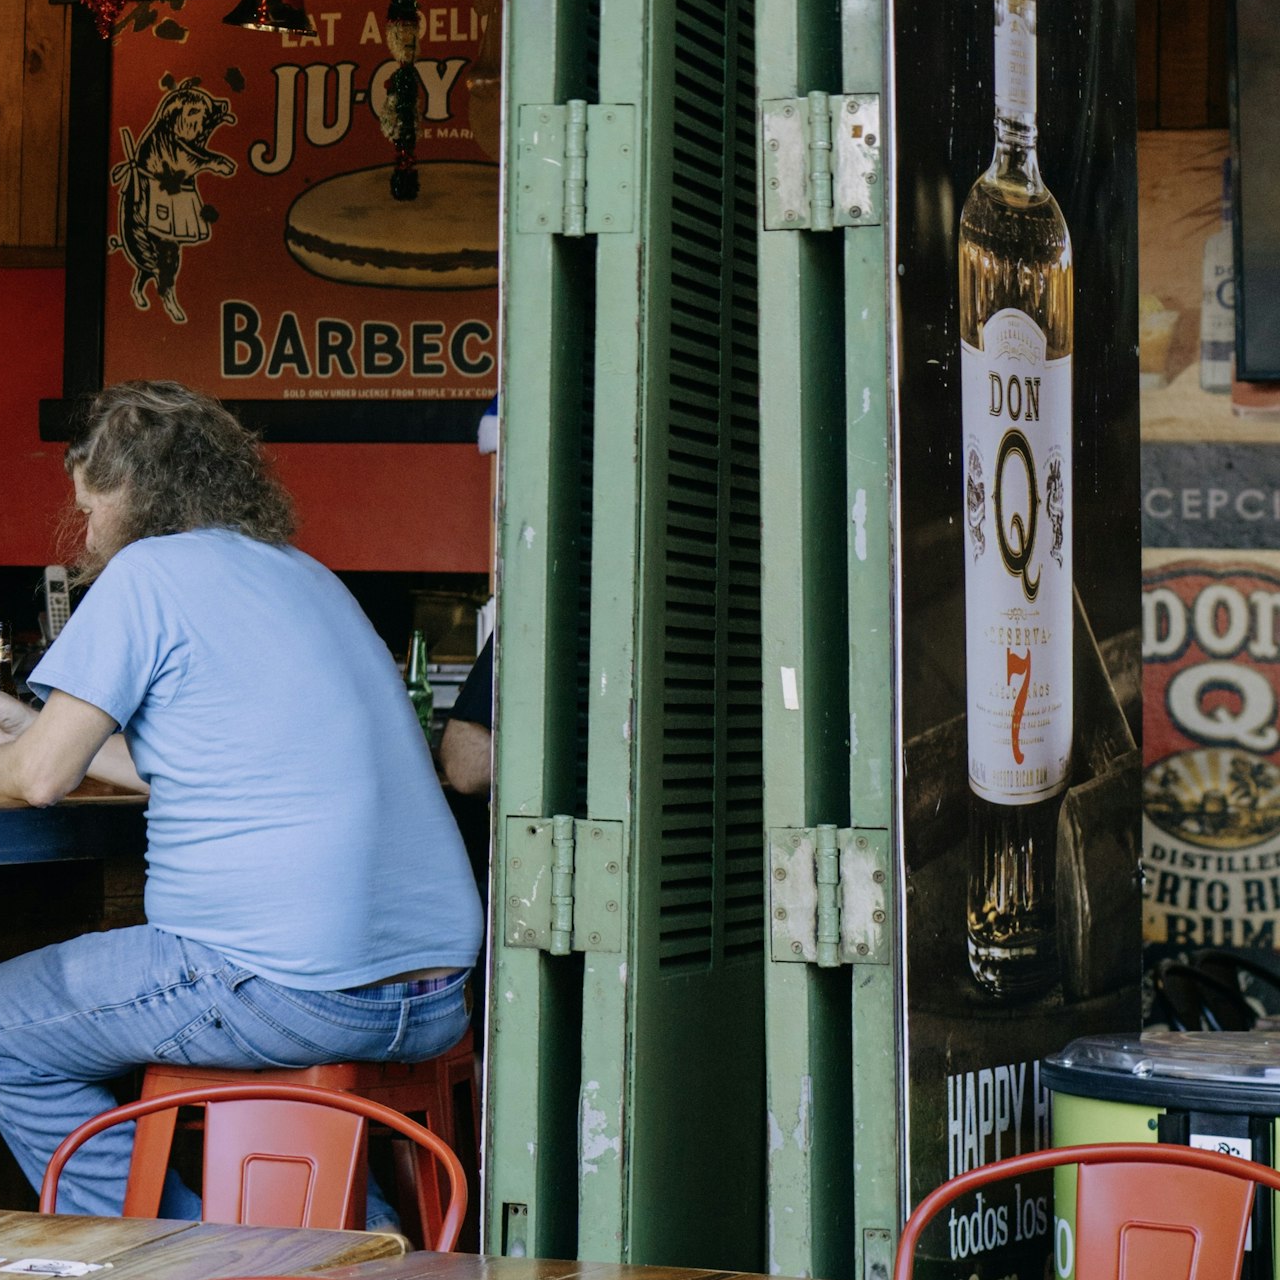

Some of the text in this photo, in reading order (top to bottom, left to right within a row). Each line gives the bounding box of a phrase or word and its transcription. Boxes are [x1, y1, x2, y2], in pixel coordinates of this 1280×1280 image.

[359, 11, 383, 45] A
[221, 299, 496, 379] BARBEC
[283, 388, 446, 399] SOLD ONLY UNDER LICENSE FROM TRIPLE
[988, 370, 1041, 422] DON
[991, 427, 1044, 603] Q
[1006, 647, 1032, 765] 7
[1166, 660, 1280, 751] Q
[1015, 766, 1048, 787] RICAN RUM
[948, 1062, 1027, 1179] HAPPY
[949, 1184, 1048, 1261] todos los
